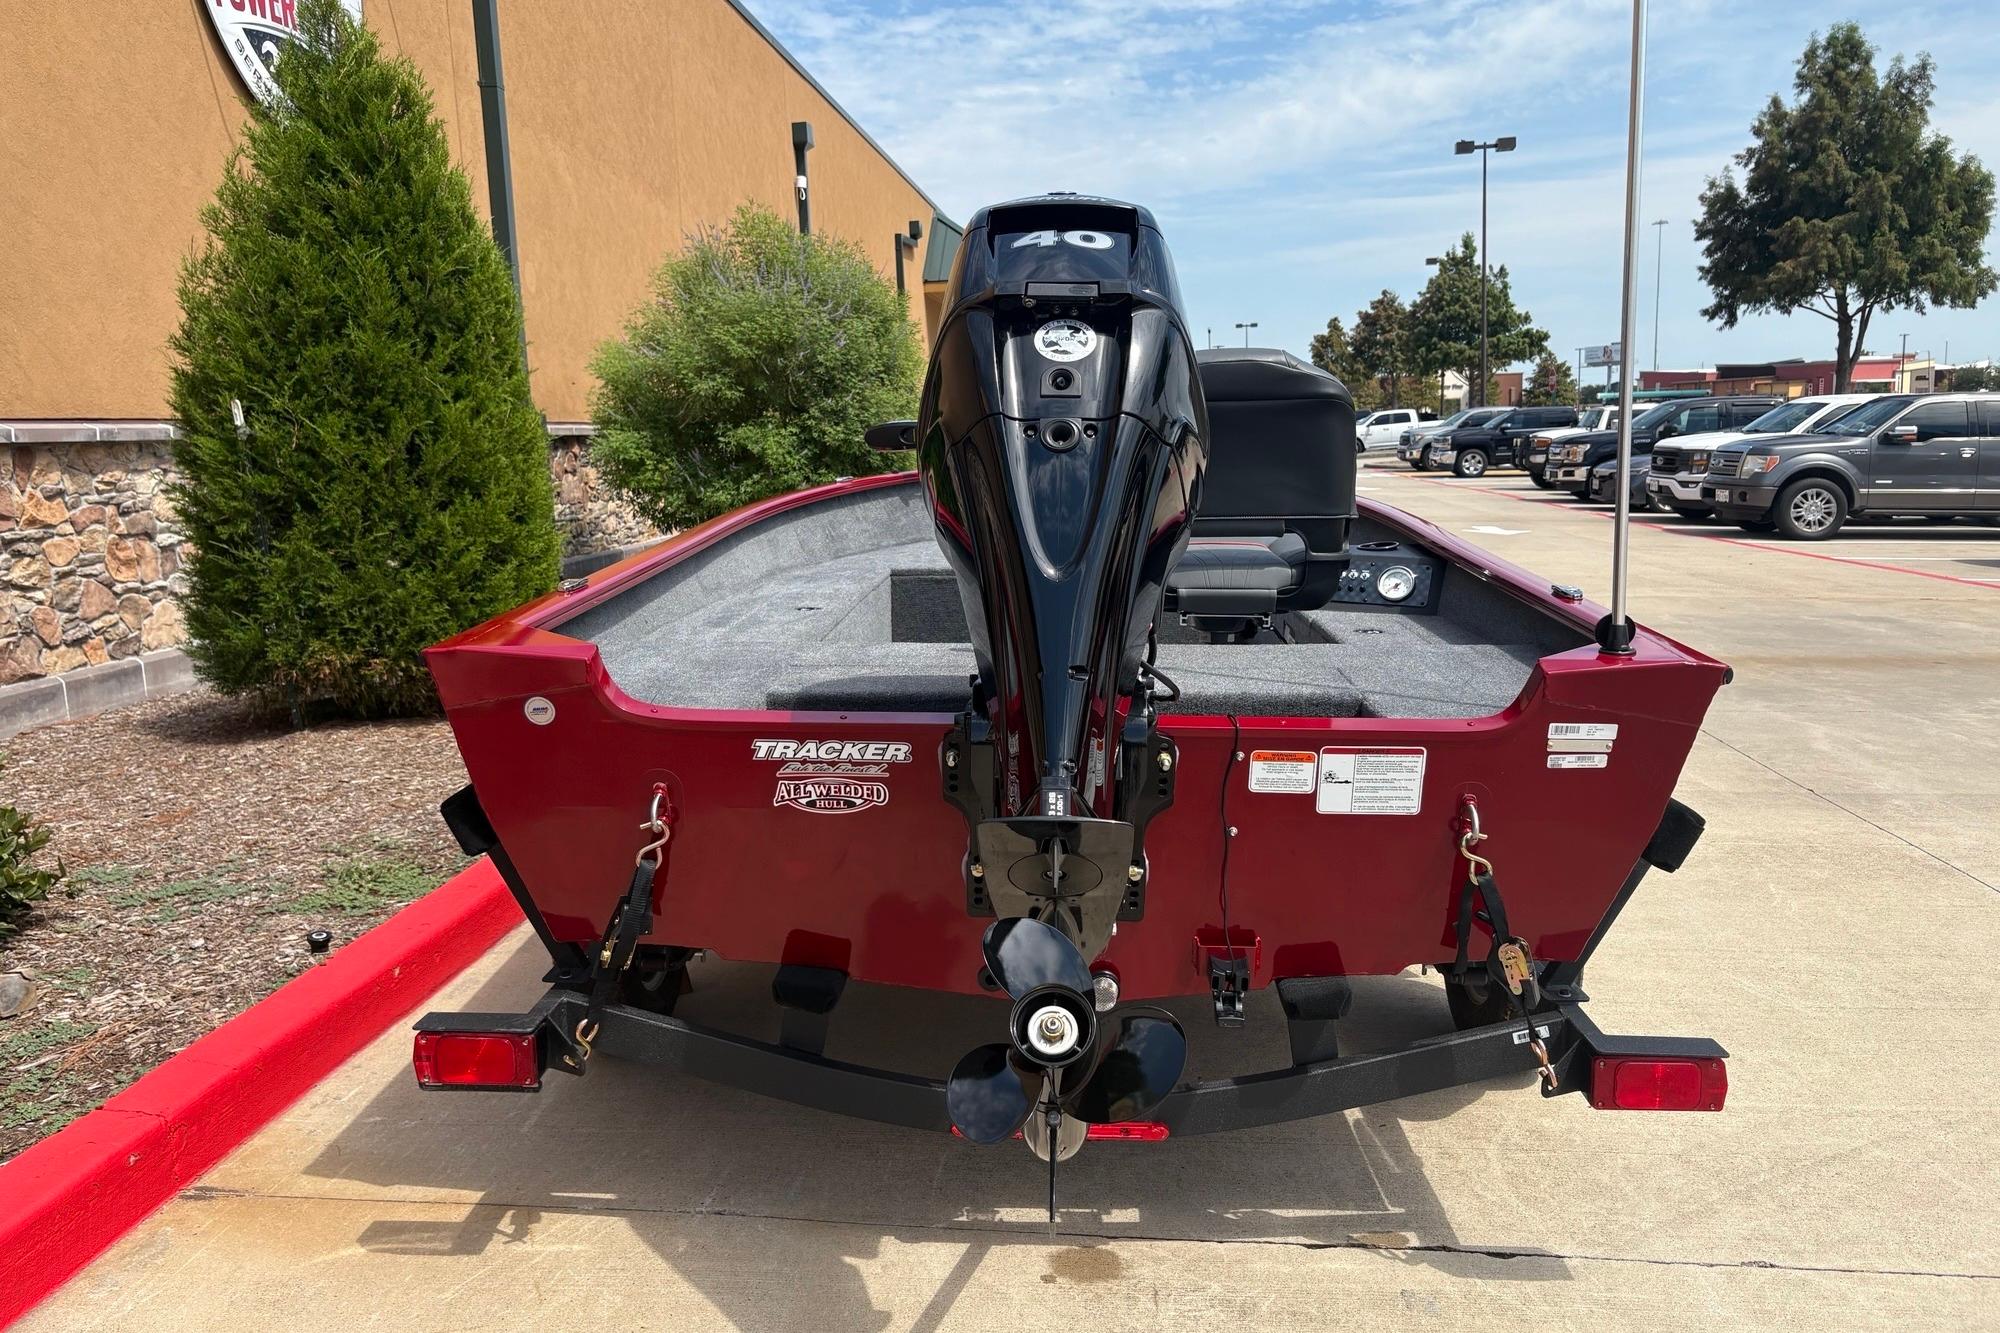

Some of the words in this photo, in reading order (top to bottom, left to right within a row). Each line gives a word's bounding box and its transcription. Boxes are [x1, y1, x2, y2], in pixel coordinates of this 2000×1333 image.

[1011, 230, 1115, 249] 40
[753, 740, 911, 761] TRACKER
[782, 763, 809, 772] Fish
[812, 764, 831, 772] the
[776, 781, 811, 802] ALL
[813, 783, 886, 803] WELDED
[816, 800, 847, 809] HULL
